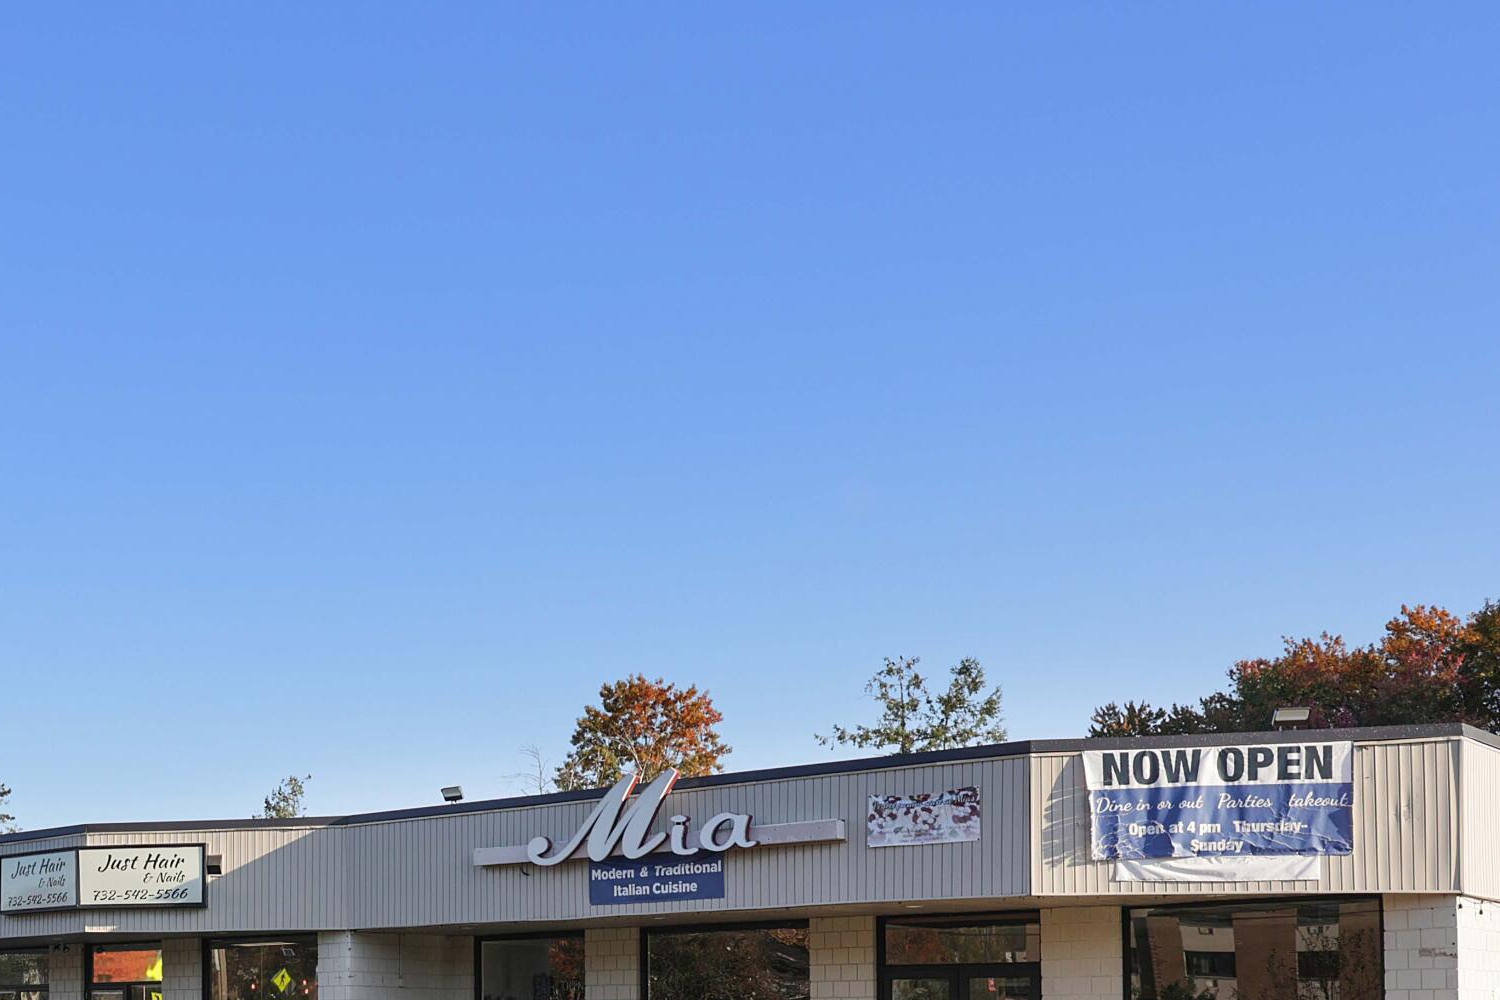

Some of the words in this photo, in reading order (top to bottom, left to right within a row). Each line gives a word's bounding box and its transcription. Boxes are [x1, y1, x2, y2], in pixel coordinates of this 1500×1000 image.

[1102, 748, 1201, 786] NOW
[1216, 745, 1333, 782] OPEN
[1097, 797, 1133, 814] Dine
[1136, 799, 1152, 811] in
[1157, 801, 1173, 810] or
[1179, 795, 1204, 809] out
[1217, 793, 1273, 809] Parties
[1288, 791, 1348, 807] takeout
[528, 768, 759, 867] Mia
[1128, 822, 1166, 837] Open
[1169, 821, 1184, 833] at
[1187, 821, 1196, 833] 4
[1199, 823, 1221, 835] pm
[1233, 820, 1308, 833] Thursday-
[1190, 839, 1243, 853] Sunday
[11, 861, 37, 879] Just
[39, 858, 65, 875] Hair
[98, 854, 138, 872] Just
[143, 853, 184, 870] Hair
[591, 868, 634, 880] Modern
[640, 866, 648, 877] &
[654, 860, 721, 877] Traditional
[47, 875, 65, 888] Nails
[143, 872, 153, 883] &
[156, 870, 185, 883] Nails
[93, 888, 188, 901] 732-542-5566
[613, 884, 650, 896] Italian
[652, 881, 697, 894] Cuisine
[8, 892, 68, 907] 732-542-5566
